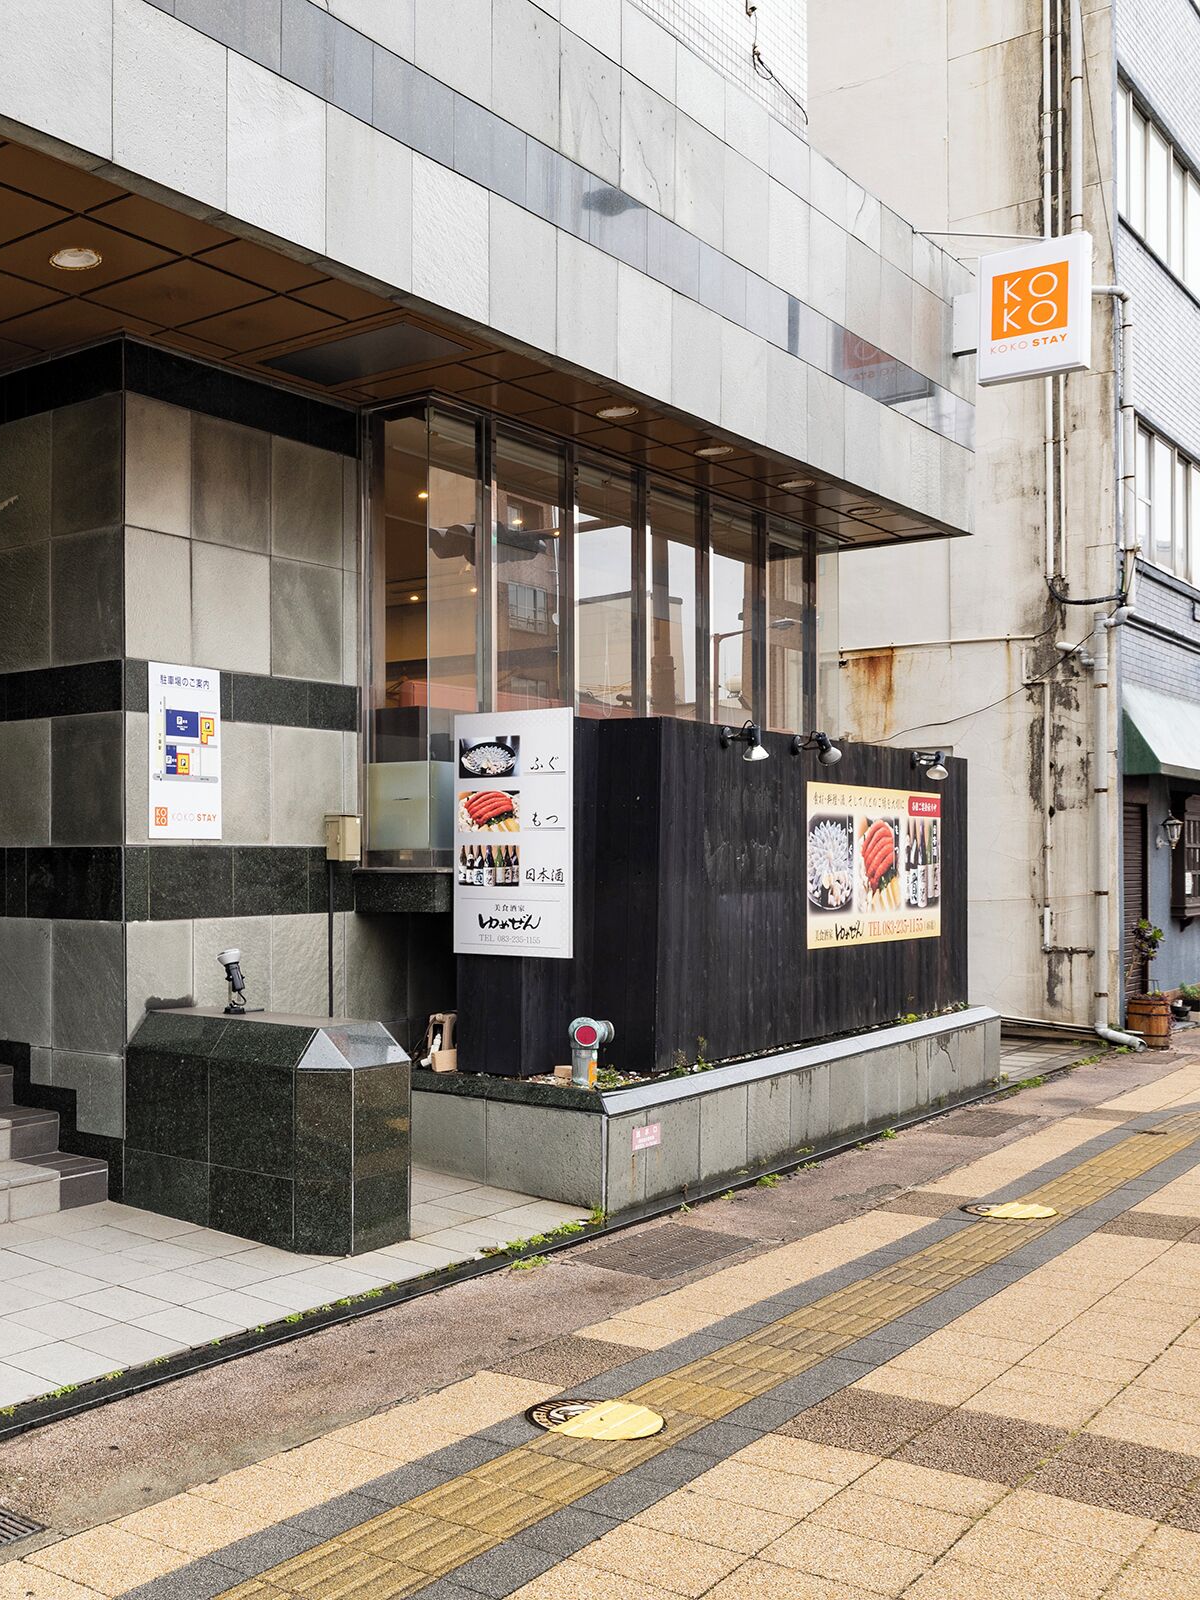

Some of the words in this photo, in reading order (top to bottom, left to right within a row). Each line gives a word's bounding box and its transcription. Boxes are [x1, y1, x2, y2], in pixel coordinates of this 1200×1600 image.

[1004, 271, 1058, 305] KO
[1003, 300, 1057, 332] KO
[990, 341, 1028, 355] KOKO
[1032, 333, 1067, 347] STAY
[160, 674, 210, 690] 駐車場のご案内
[530, 756, 559, 770] ふぐ
[156, 808, 167, 817] KO
[171, 812, 195, 822] KOKO
[196, 813, 216, 822] STAY
[532, 812, 558, 827] もつ
[526, 867, 564, 883] 日本酒
[495, 904, 525, 912] 美食酒家
[868, 921, 881, 936] TEL
[497, 935, 541, 944] 083-235-1155
